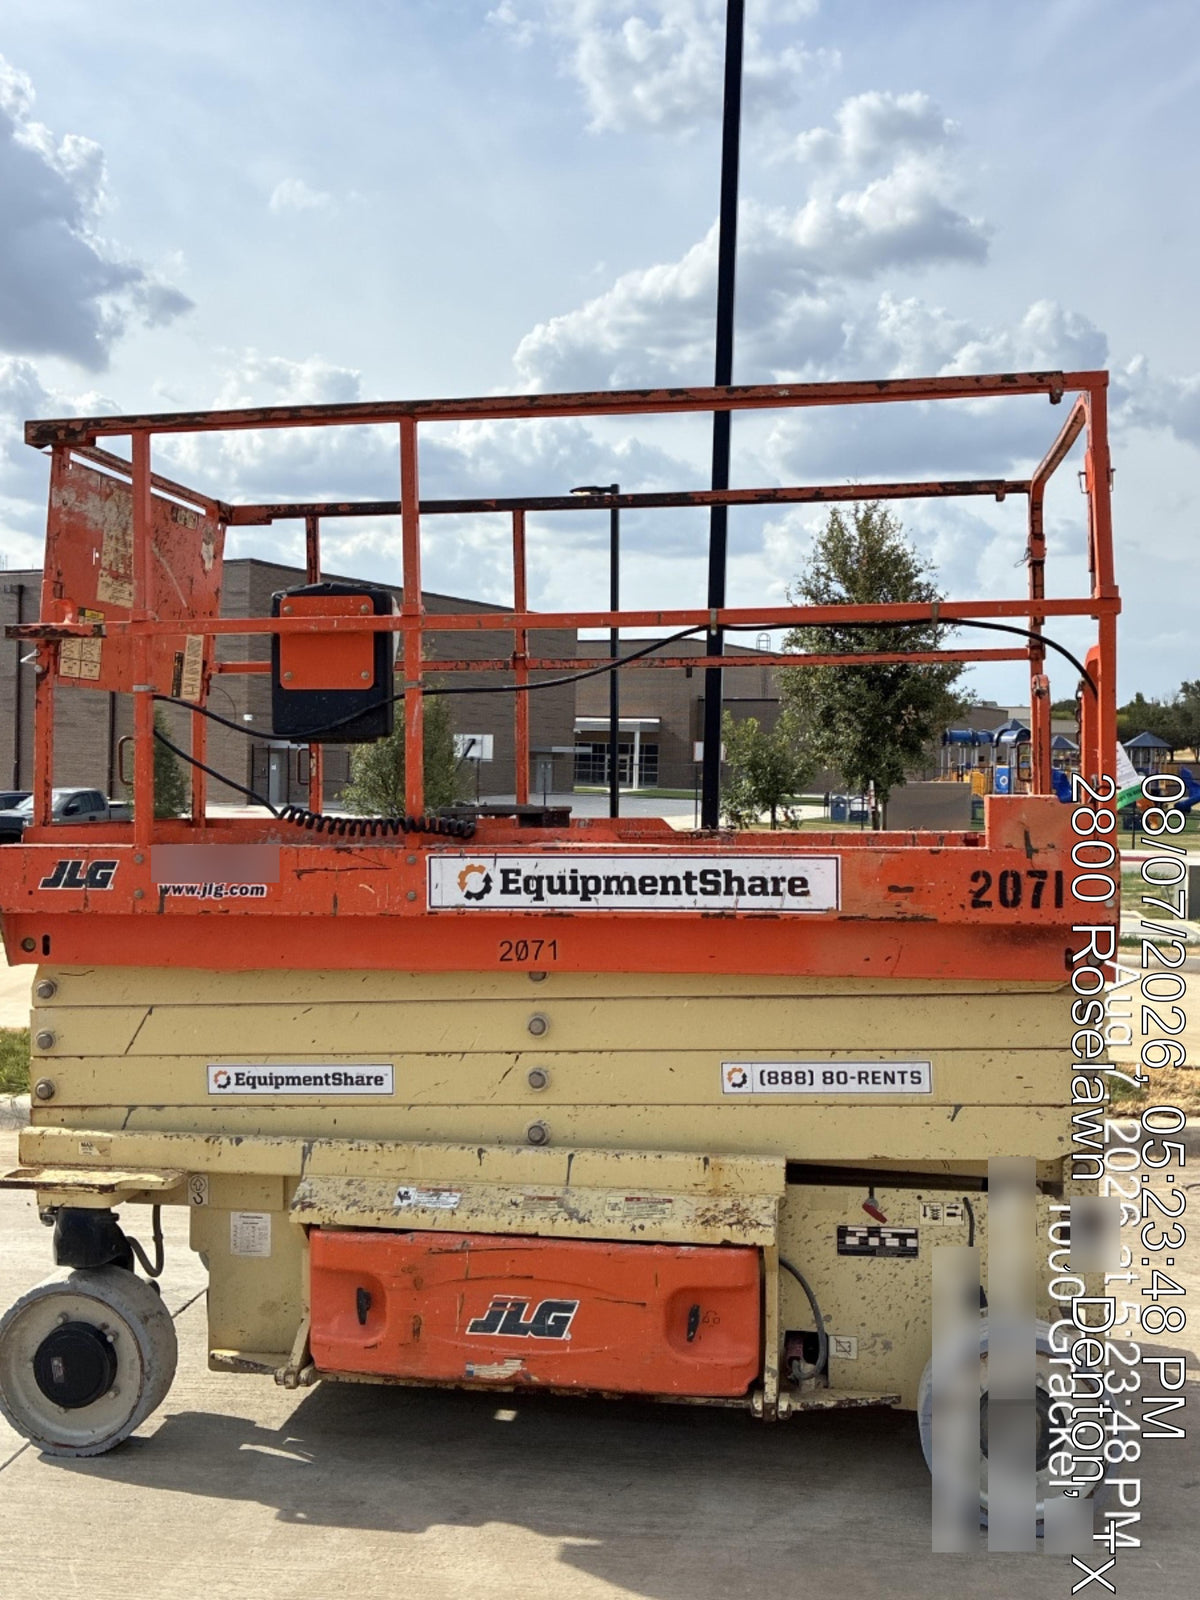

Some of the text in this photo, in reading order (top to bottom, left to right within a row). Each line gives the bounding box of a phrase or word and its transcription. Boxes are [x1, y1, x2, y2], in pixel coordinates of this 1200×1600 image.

[38, 860, 119, 889] JLG
[500, 869, 810, 901] EquipmentShare
[158, 883, 267, 898] www.jlg.com
[969, 870, 1064, 909] 2071
[499, 939, 559, 962] 2071
[234, 1072, 385, 1089] EquipmentShare
[759, 1069, 922, 1086] (888) 80-RENTS
[466, 1295, 580, 1340] JLG
